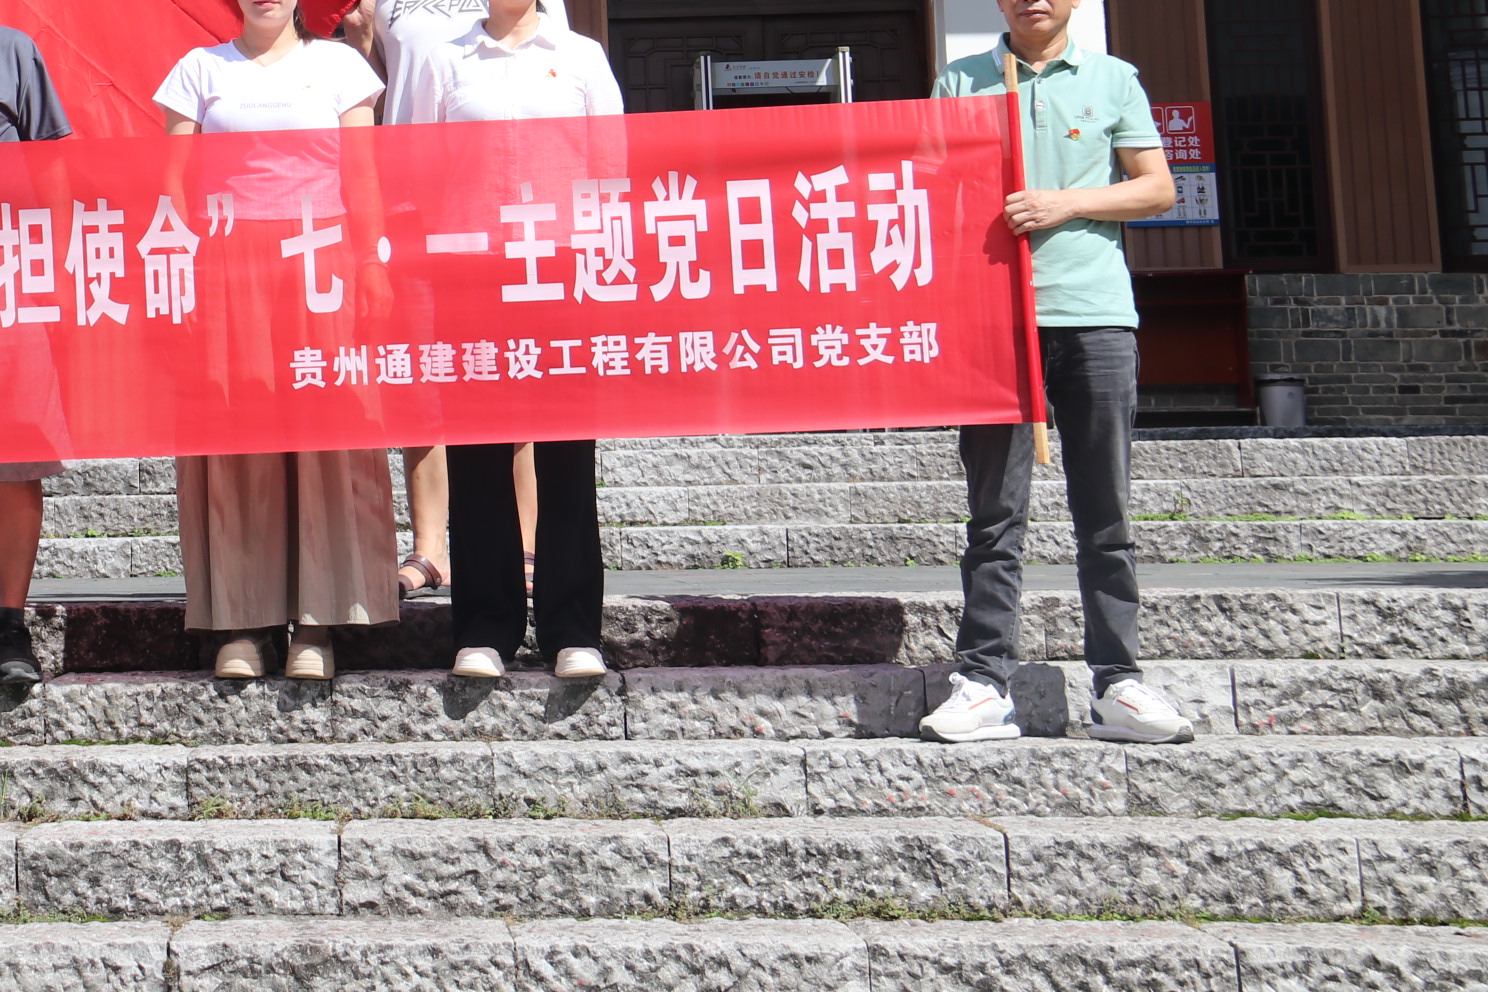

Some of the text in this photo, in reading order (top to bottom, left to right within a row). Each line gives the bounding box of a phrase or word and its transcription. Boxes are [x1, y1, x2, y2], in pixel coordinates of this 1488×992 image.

[289, 321, 941, 391] 贵州通建建设工程有限公司党支部
